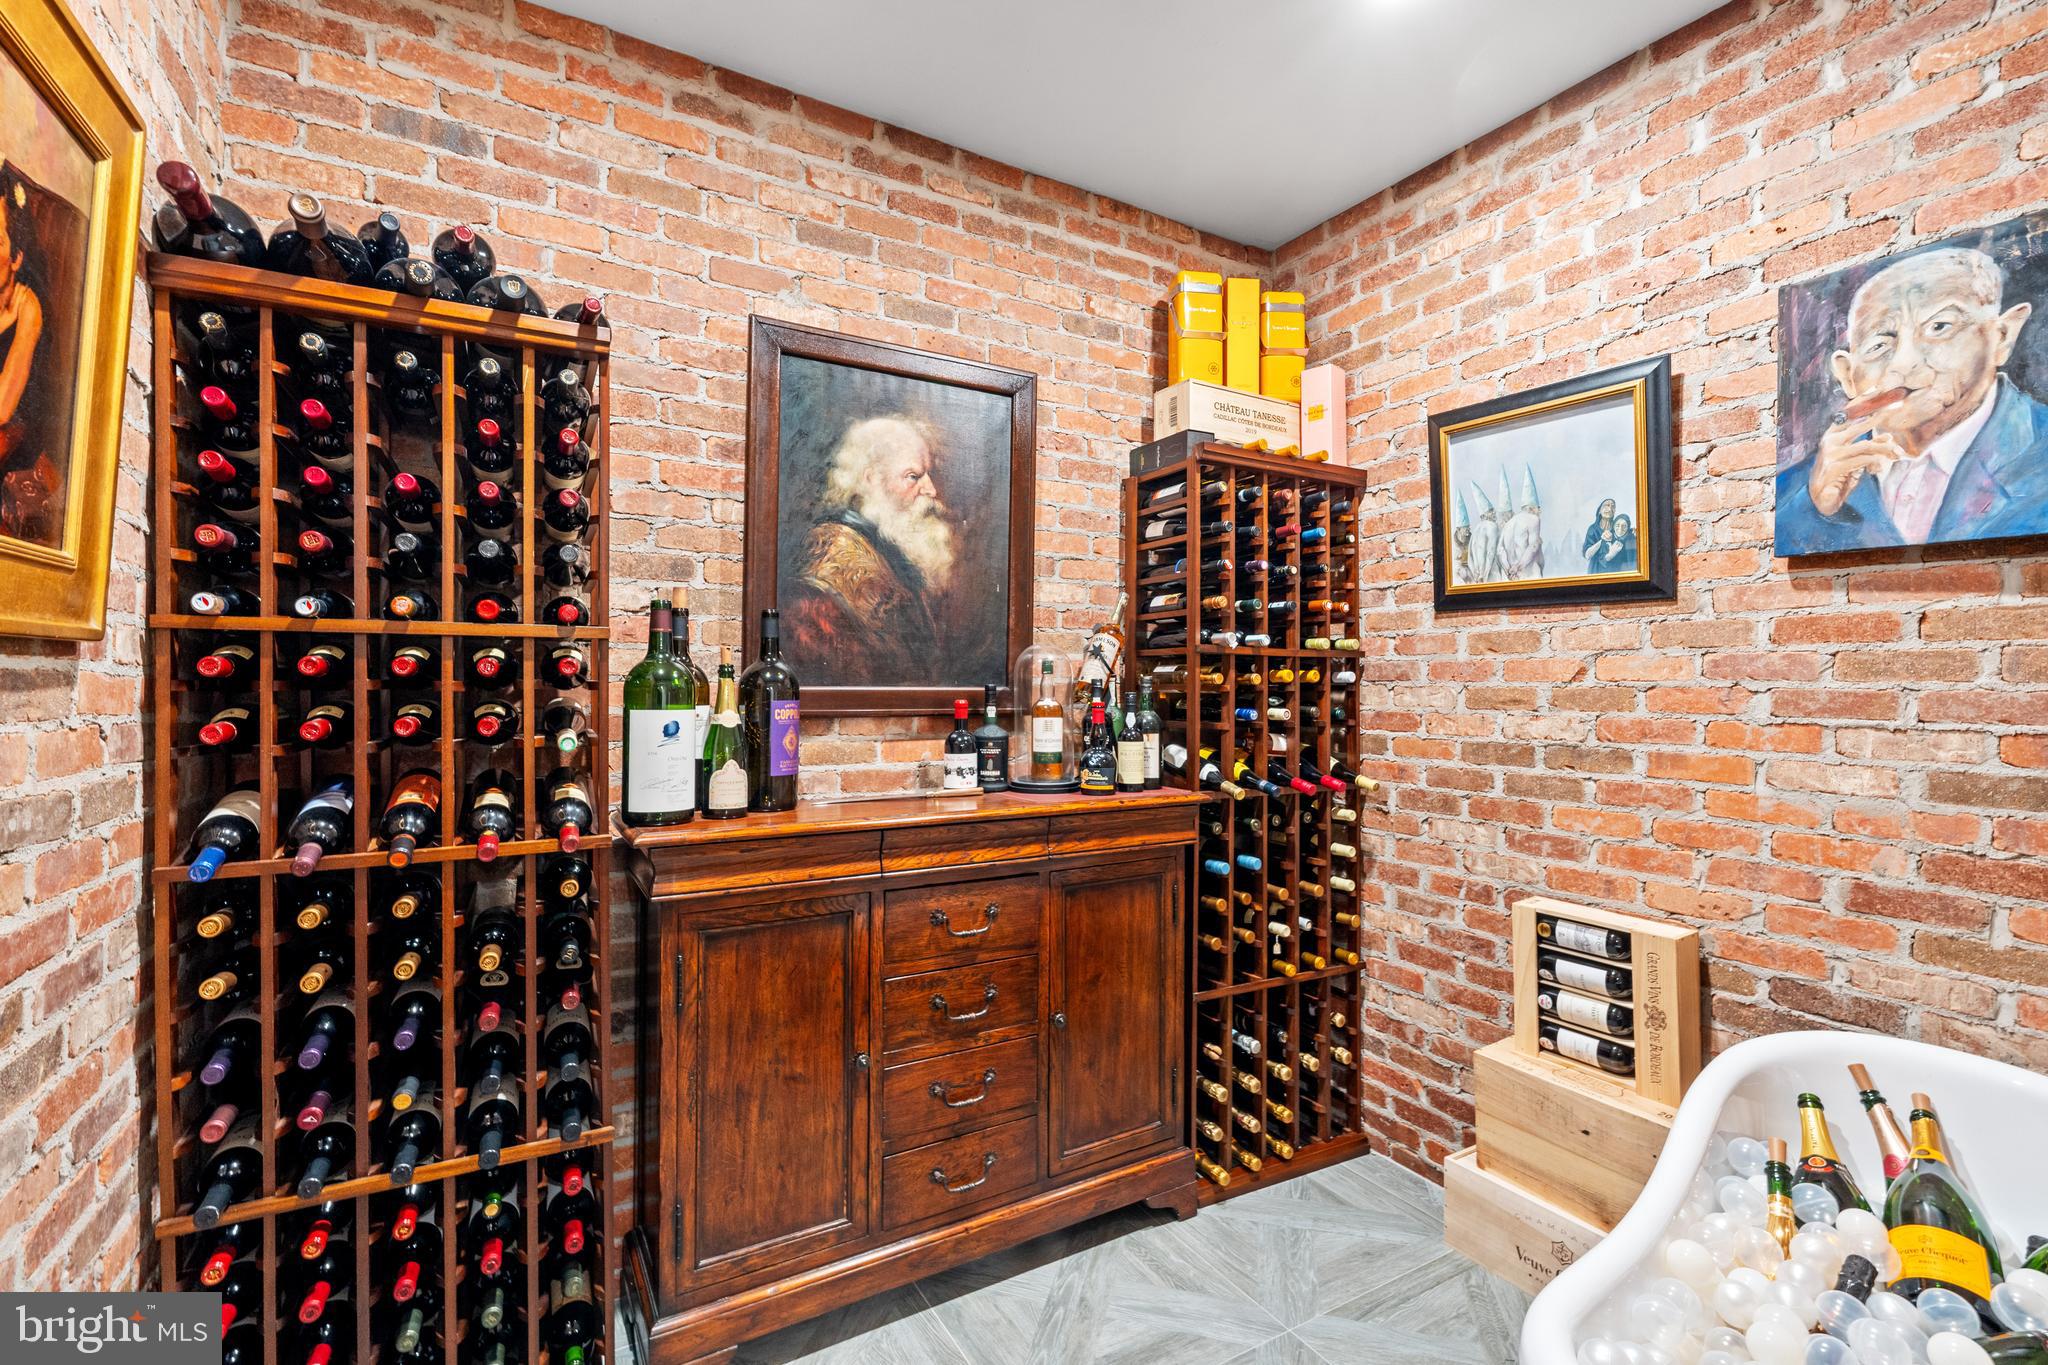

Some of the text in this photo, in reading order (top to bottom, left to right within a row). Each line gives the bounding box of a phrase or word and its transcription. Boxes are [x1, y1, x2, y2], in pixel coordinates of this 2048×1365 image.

[1214, 401, 1286, 425] CHÂTEAU TANESSE
[1262, 422, 1288, 433] BORDEAUX
[1646, 951, 1663, 1086] GRANDS VINS DE BORDEAUX
[1515, 1244, 1553, 1277] Veuve
